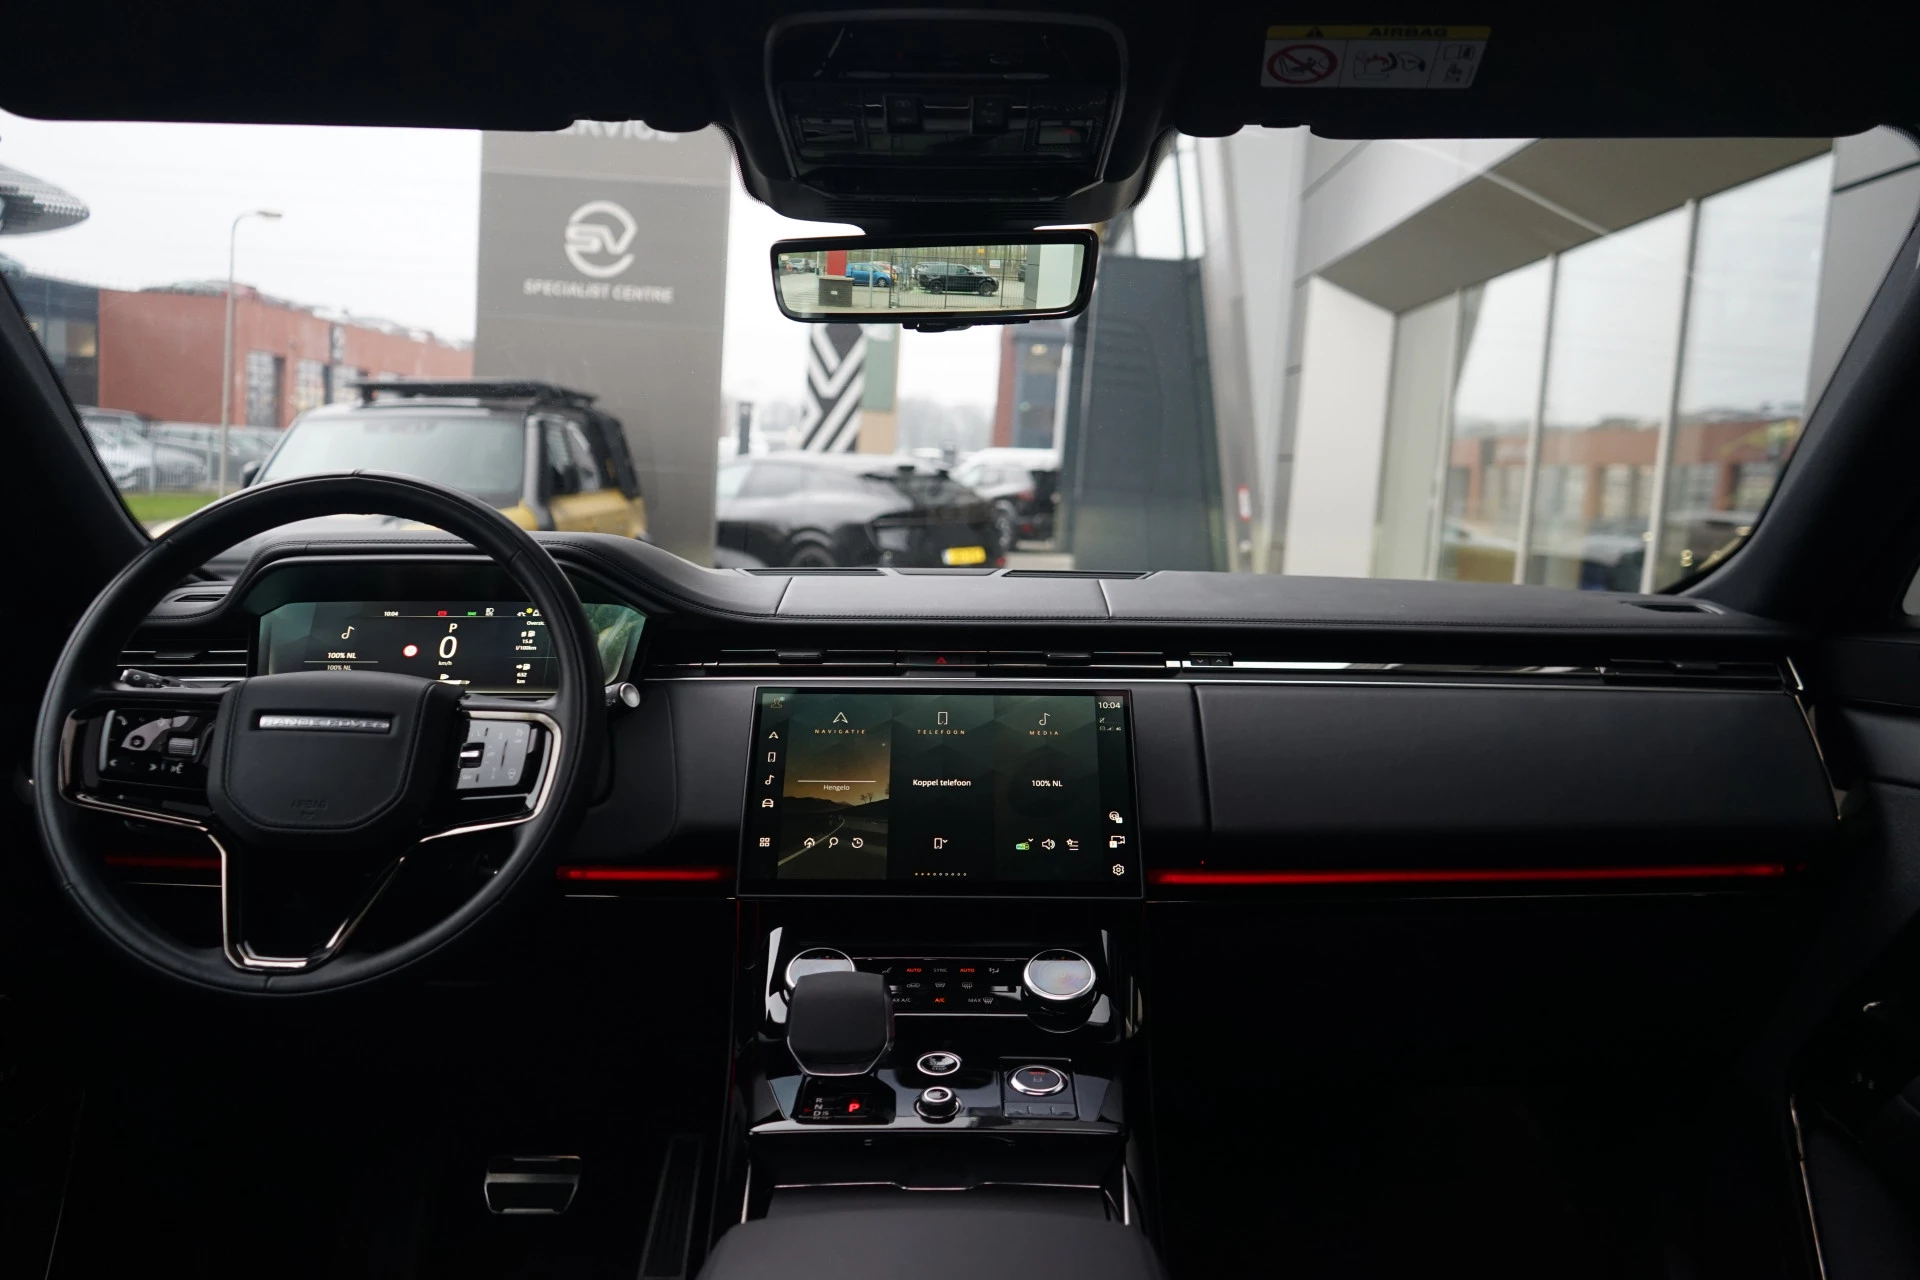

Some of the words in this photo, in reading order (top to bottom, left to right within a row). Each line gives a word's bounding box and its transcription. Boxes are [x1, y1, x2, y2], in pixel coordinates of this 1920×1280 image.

[1369, 27, 1448, 37] AIRBAG
[523, 278, 611, 299] SPECIALIST
[611, 285, 674, 304] CENTRE
[448, 623, 457, 632] P
[439, 635, 457, 659] 0
[912, 779, 939, 788] Koppel
[939, 779, 972, 787] telefoon
[848, 1103, 861, 1112] P
